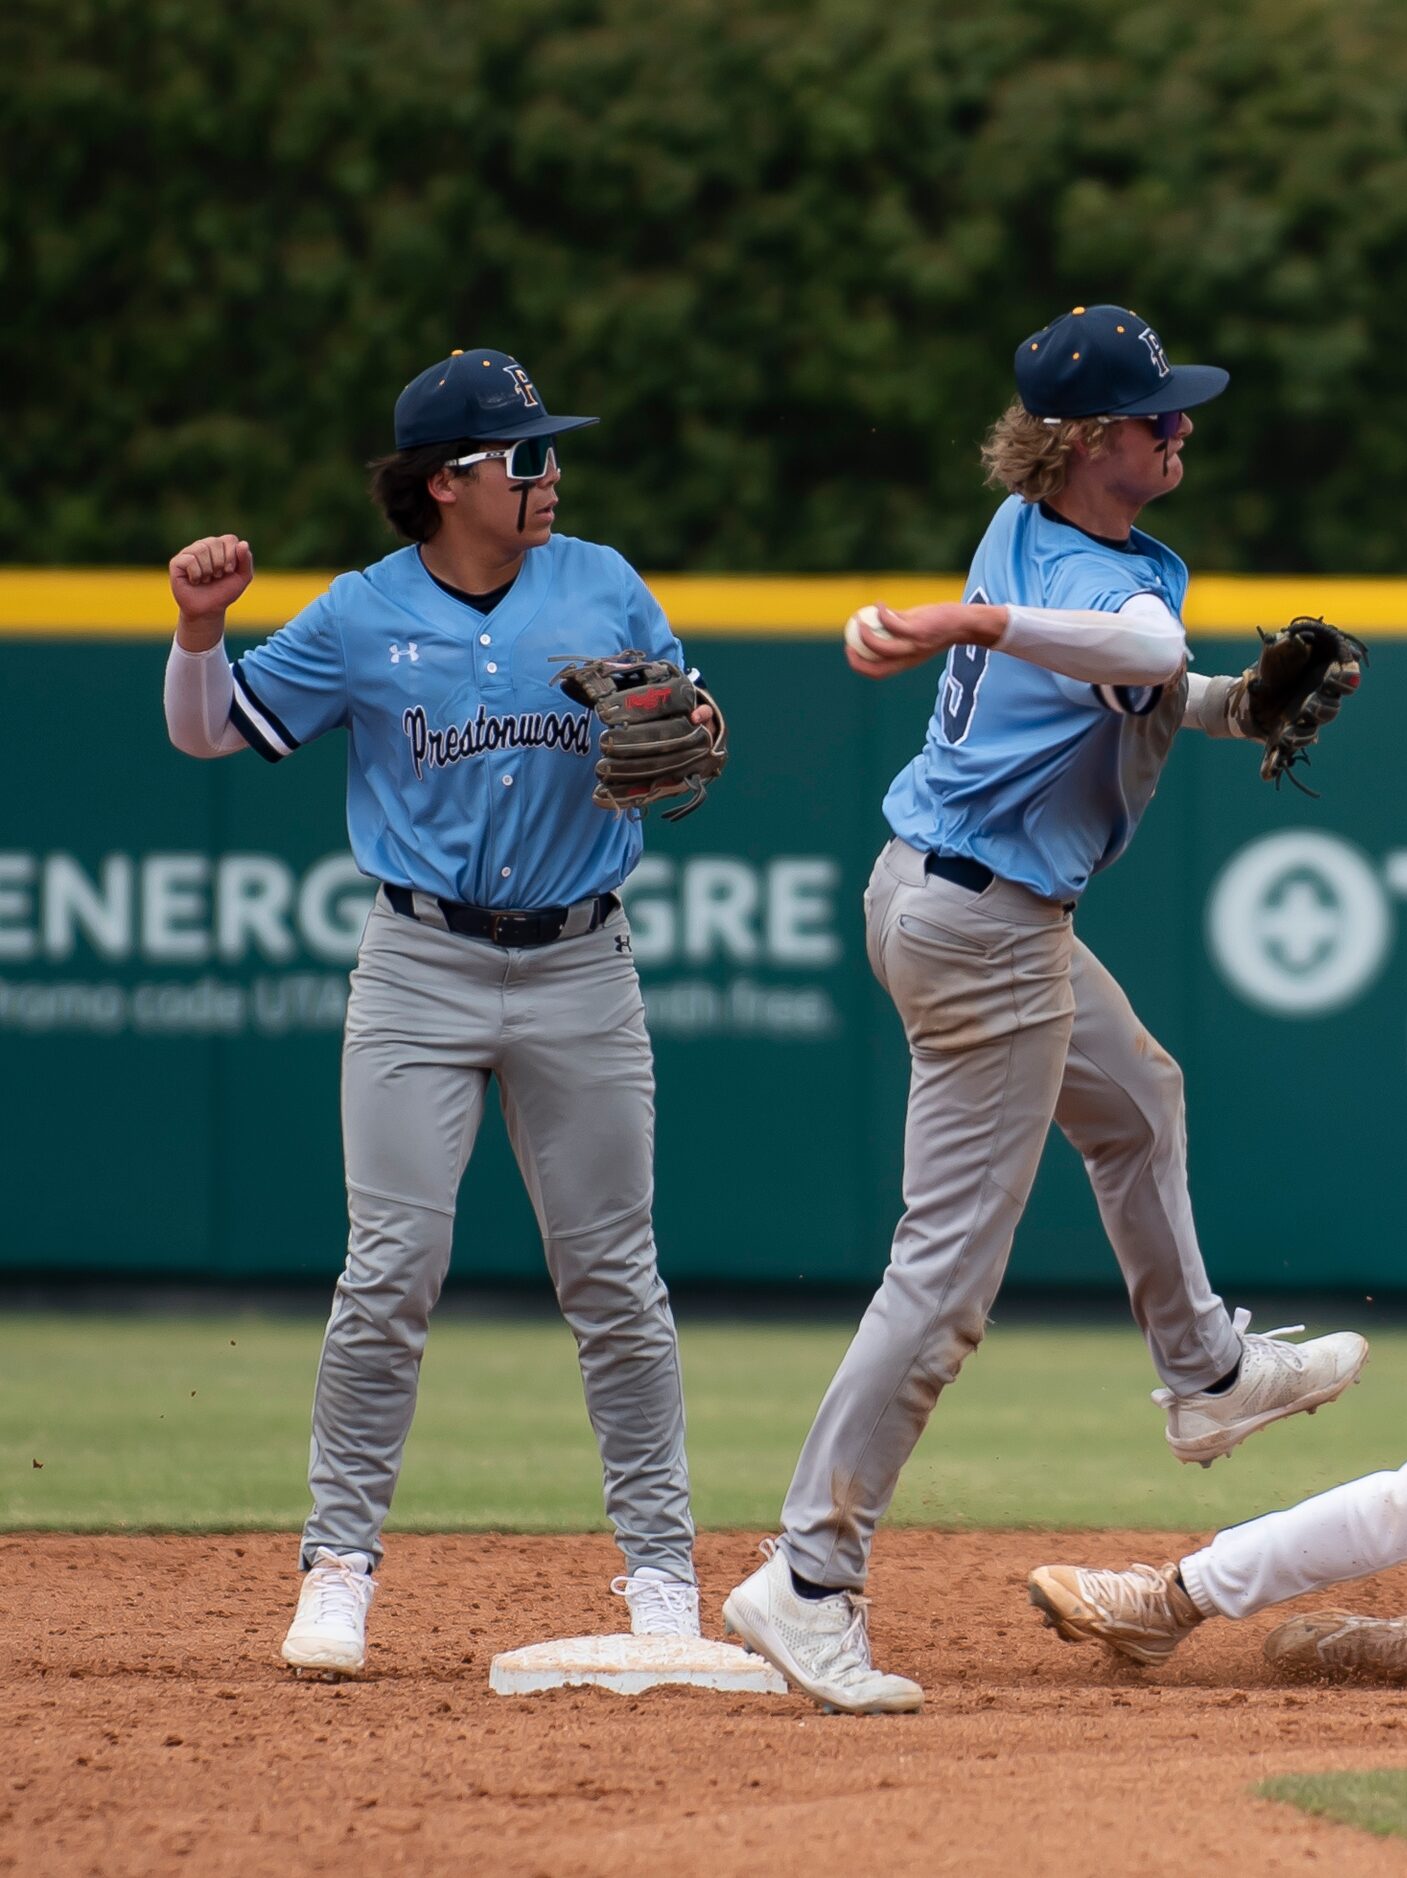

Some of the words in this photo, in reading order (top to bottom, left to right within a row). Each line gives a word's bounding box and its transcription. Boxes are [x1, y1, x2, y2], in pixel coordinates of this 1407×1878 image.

[402, 704, 592, 781] Prestonwood
[0, 852, 372, 960] ENERG
[618, 854, 840, 962] GRE
[0, 978, 125, 1030] romo
